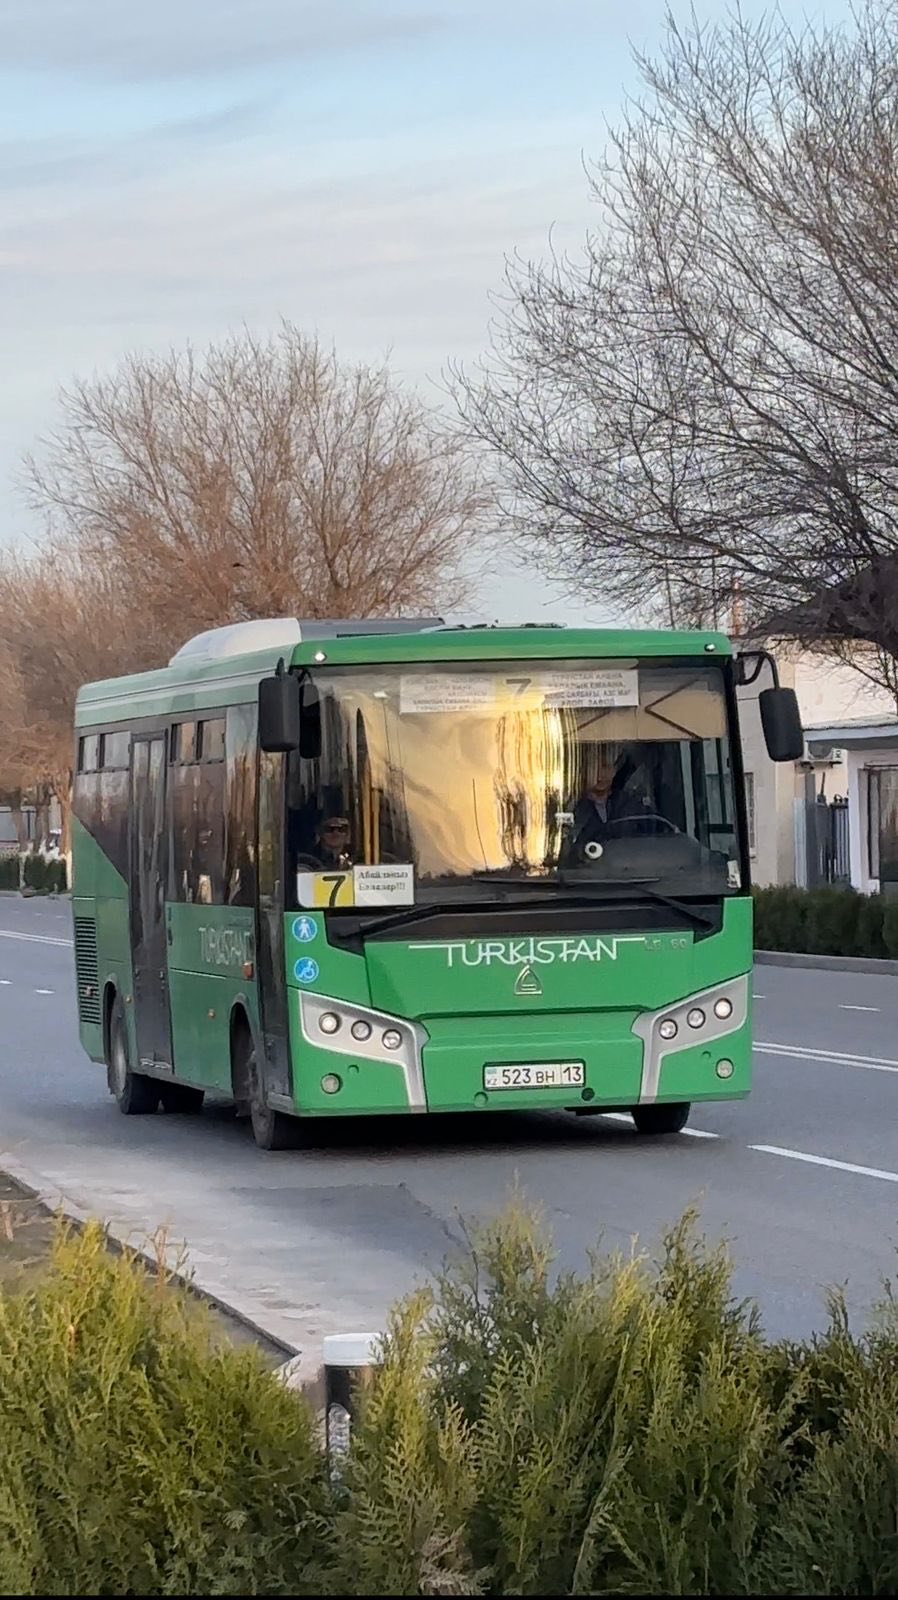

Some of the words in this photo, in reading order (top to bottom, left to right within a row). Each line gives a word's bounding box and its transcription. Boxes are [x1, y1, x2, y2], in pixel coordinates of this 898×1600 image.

[505, 678, 532, 702] 7
[322, 875, 346, 908] 7
[502, 1068, 531, 1085] 523
[563, 1066, 581, 1082] 13
